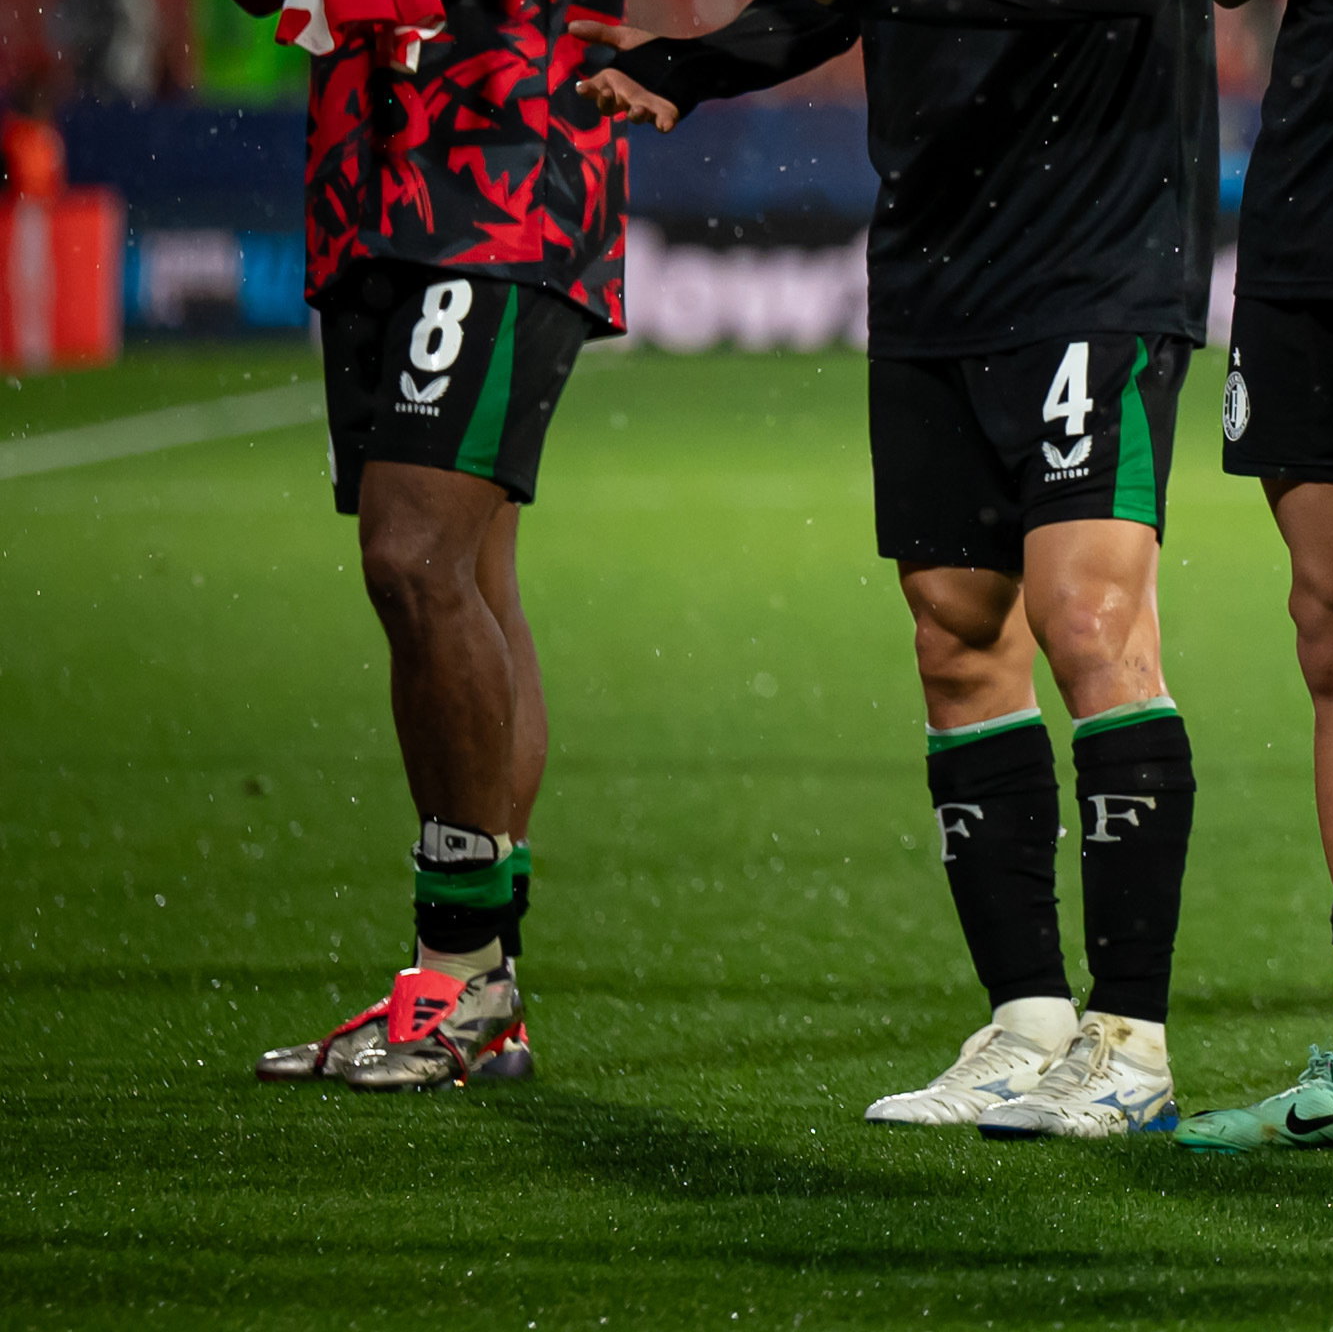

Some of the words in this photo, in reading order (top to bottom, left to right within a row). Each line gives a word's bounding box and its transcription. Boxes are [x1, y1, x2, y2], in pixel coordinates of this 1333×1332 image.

[410, 279, 473, 372] 8
[1042, 341, 1094, 436] 4
[1044, 467, 1090, 483] CASTORE
[1086, 794, 1157, 843] F
